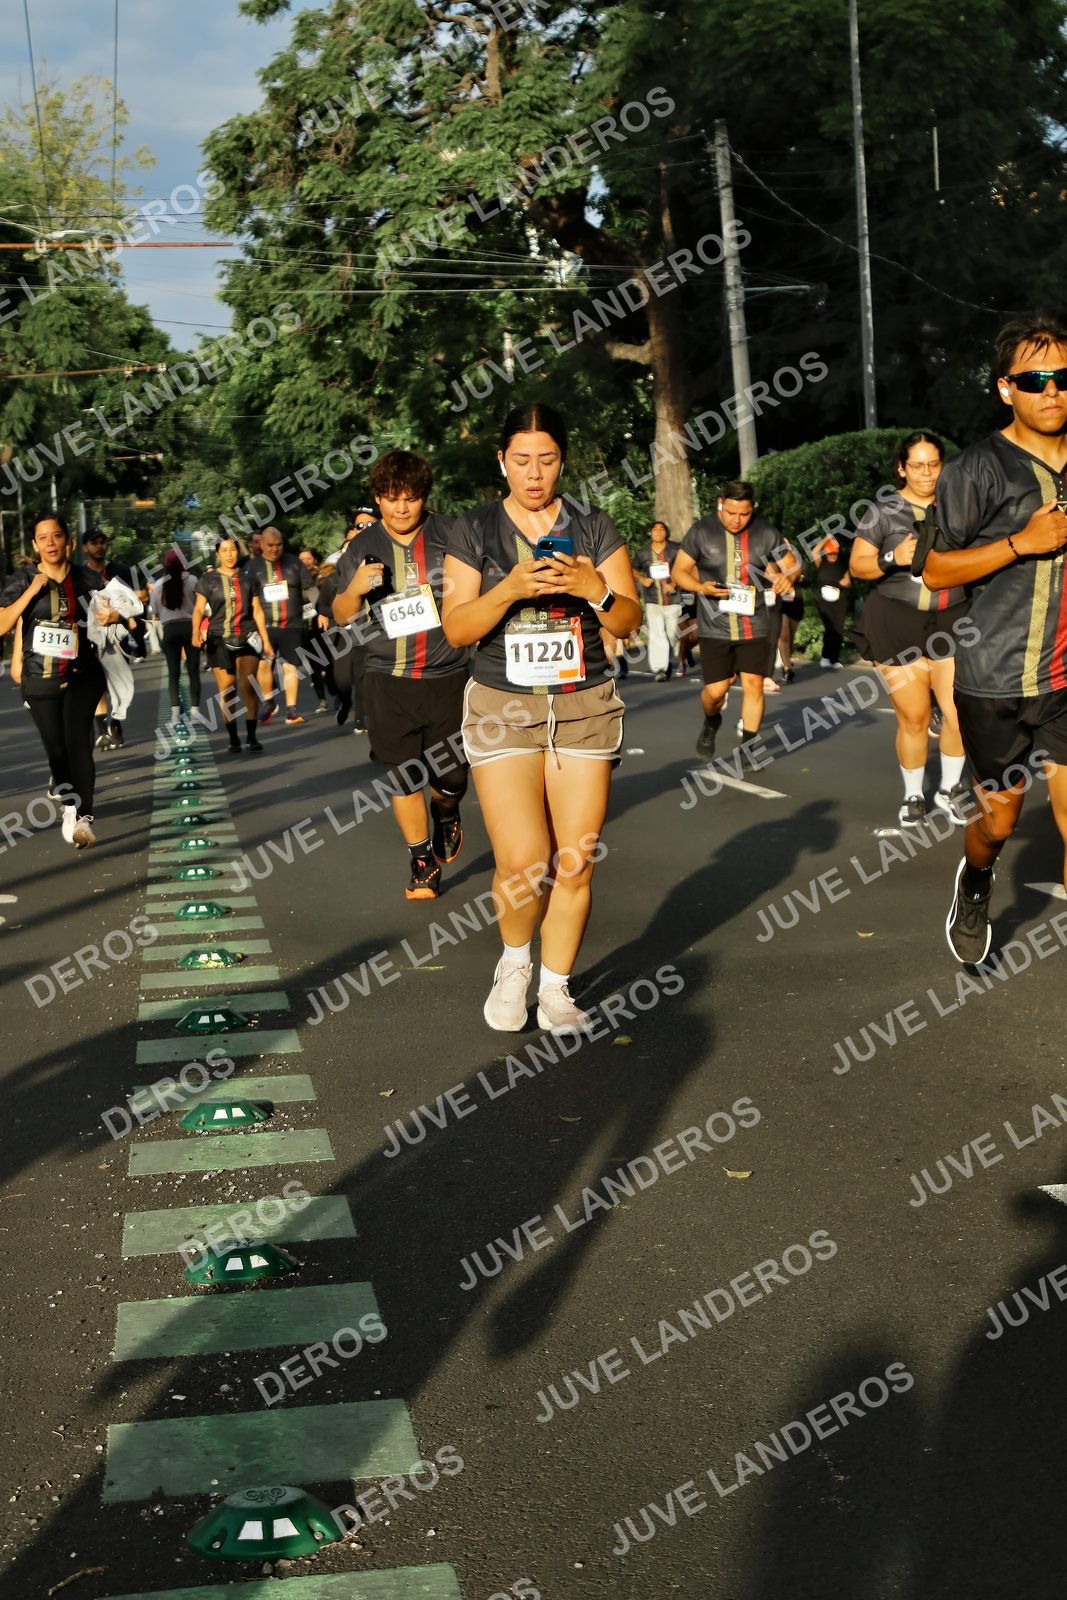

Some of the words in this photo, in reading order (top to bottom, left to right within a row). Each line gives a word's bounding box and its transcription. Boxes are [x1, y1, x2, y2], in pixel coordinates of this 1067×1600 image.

[389, 601, 425, 622] 6546
[39, 631, 70, 646] 3314
[510, 639, 575, 663] 11220
